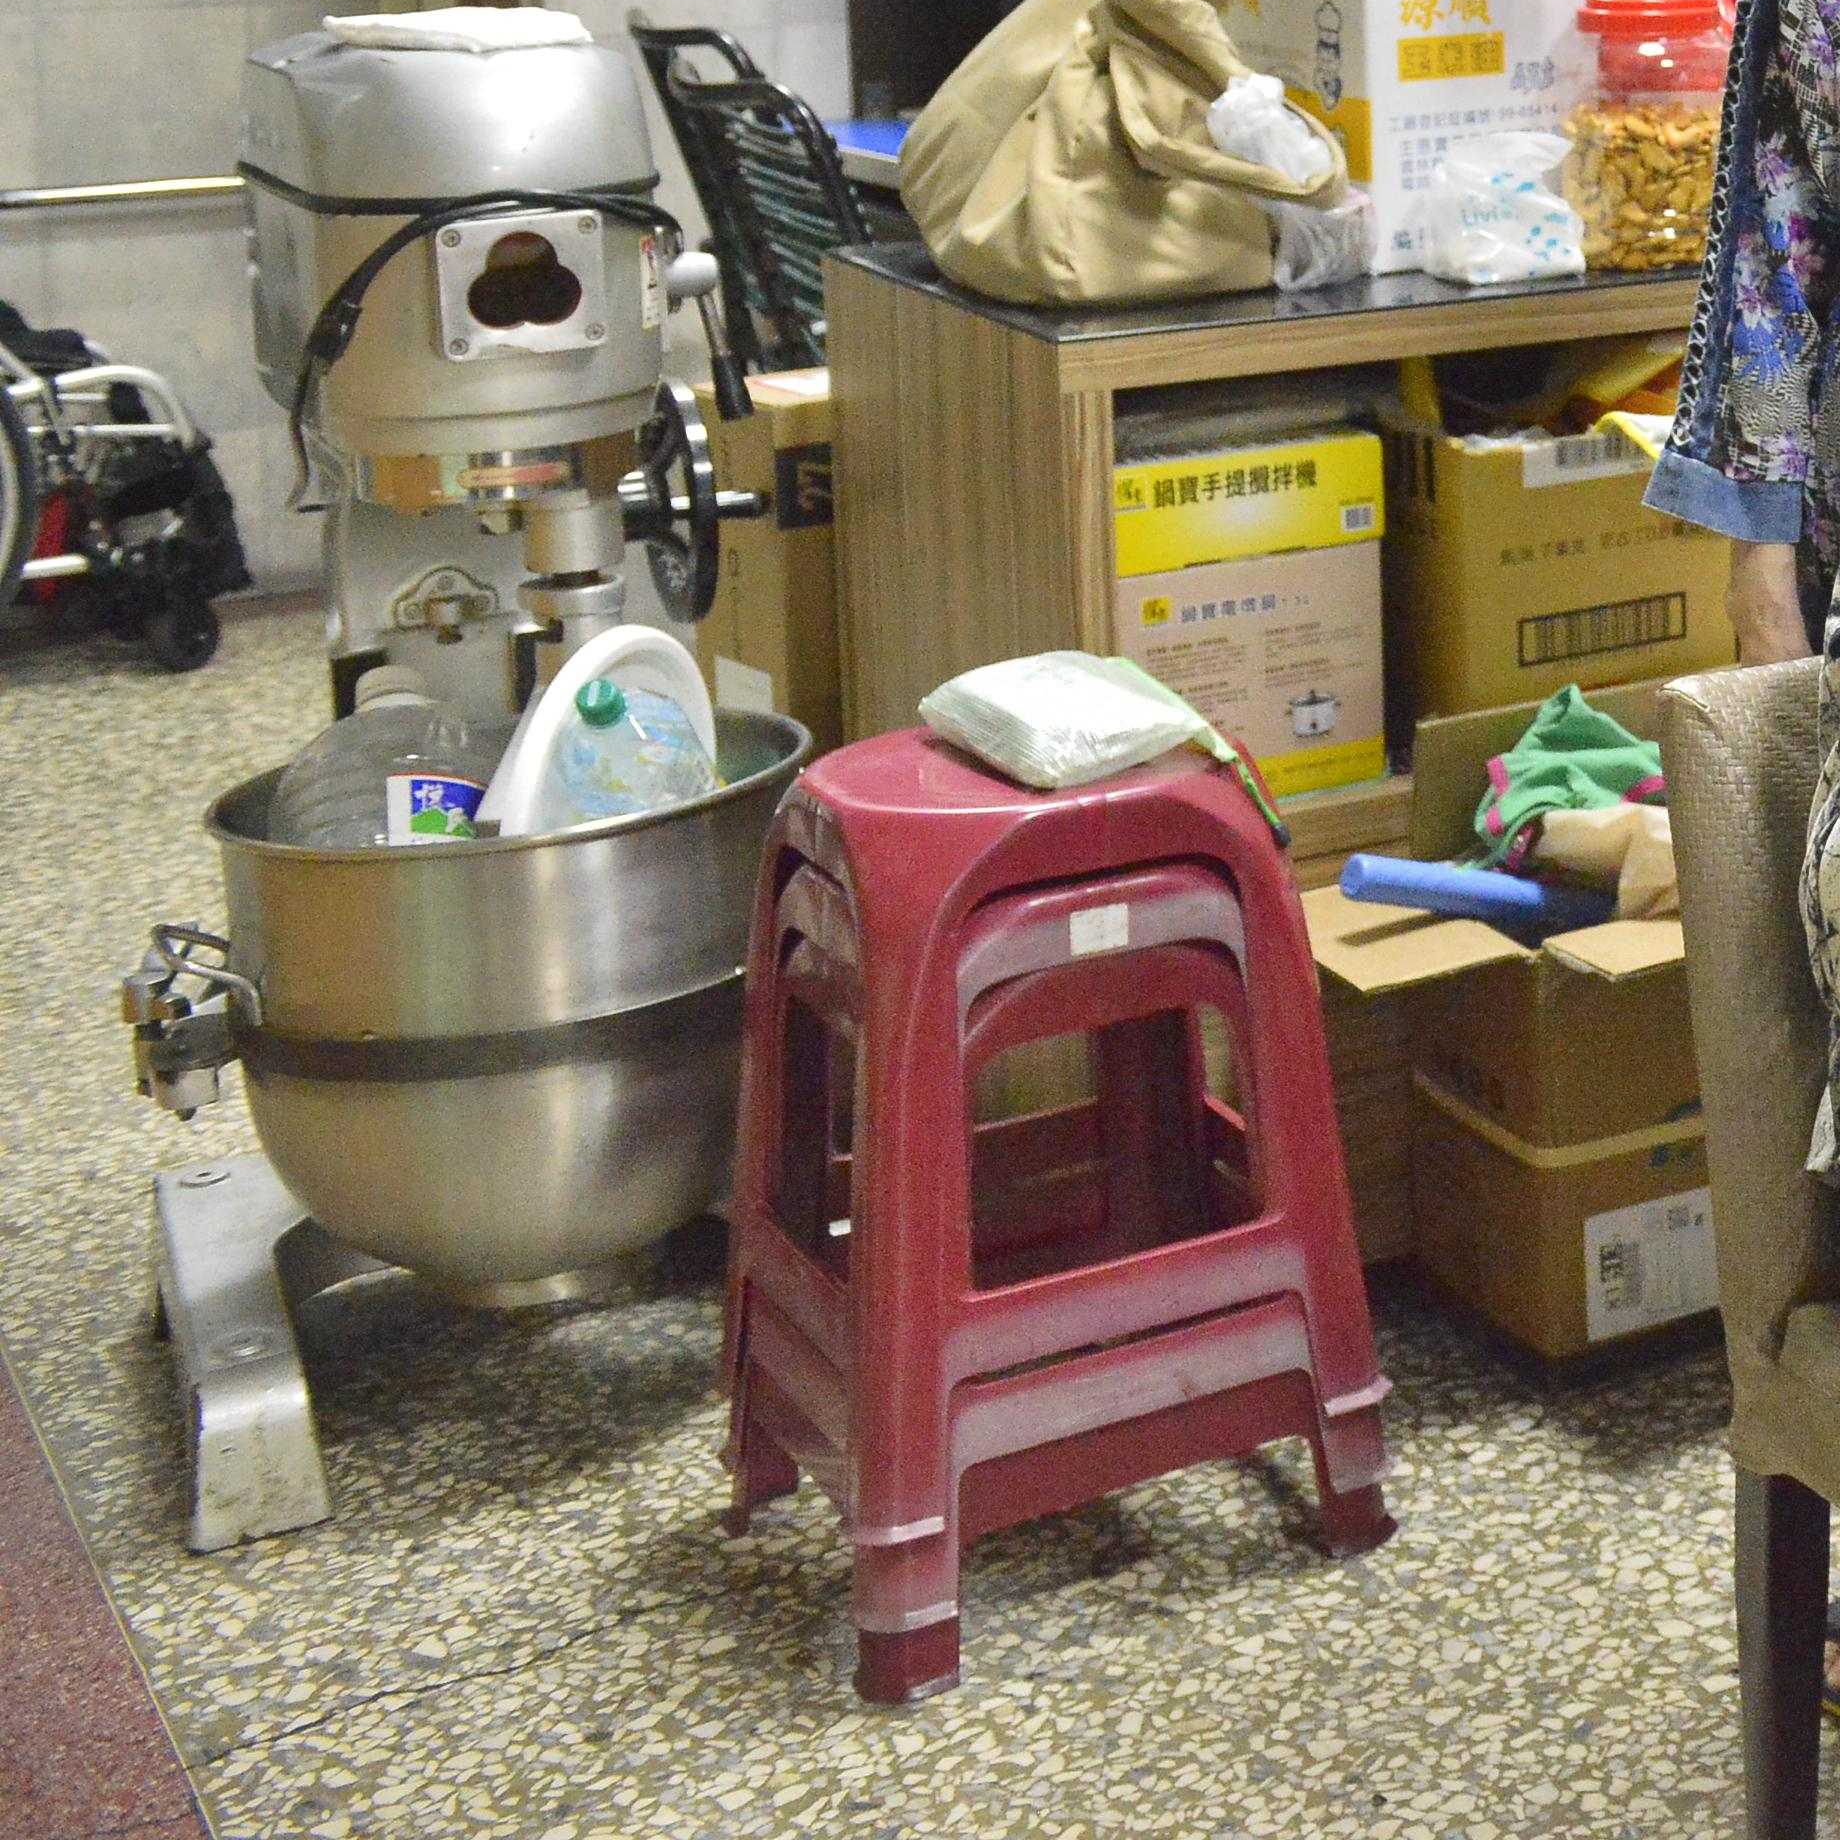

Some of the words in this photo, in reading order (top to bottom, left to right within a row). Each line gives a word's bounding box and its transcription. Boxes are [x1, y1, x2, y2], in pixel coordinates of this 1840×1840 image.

[1153, 459, 1317, 508] 鍋寶手提攪拌機
